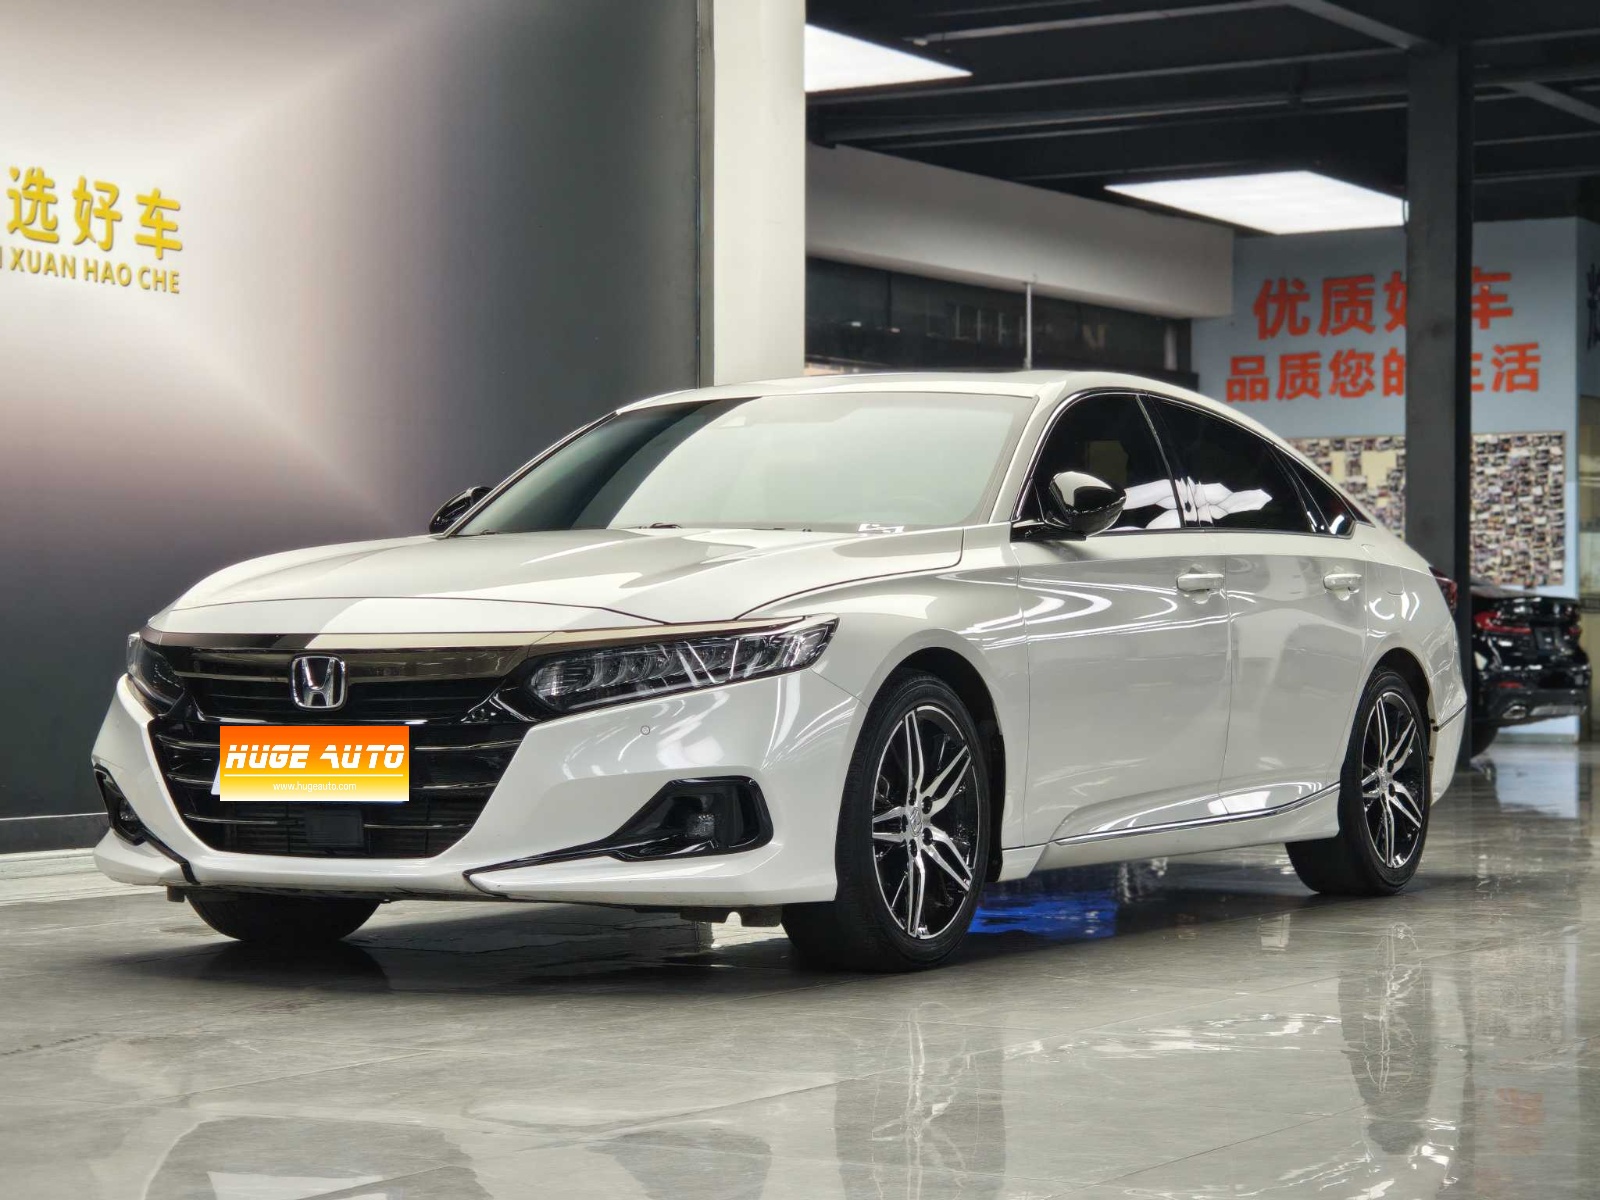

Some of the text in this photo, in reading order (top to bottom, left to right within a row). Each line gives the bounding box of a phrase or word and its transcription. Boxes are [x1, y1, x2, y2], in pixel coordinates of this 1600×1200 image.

[7, 167, 183, 260] 选好车
[10, 247, 76, 279] XUAN
[82, 257, 132, 287] HAO
[137, 265, 181, 294] CHE
[1226, 343, 1540, 402] 品质您的活
